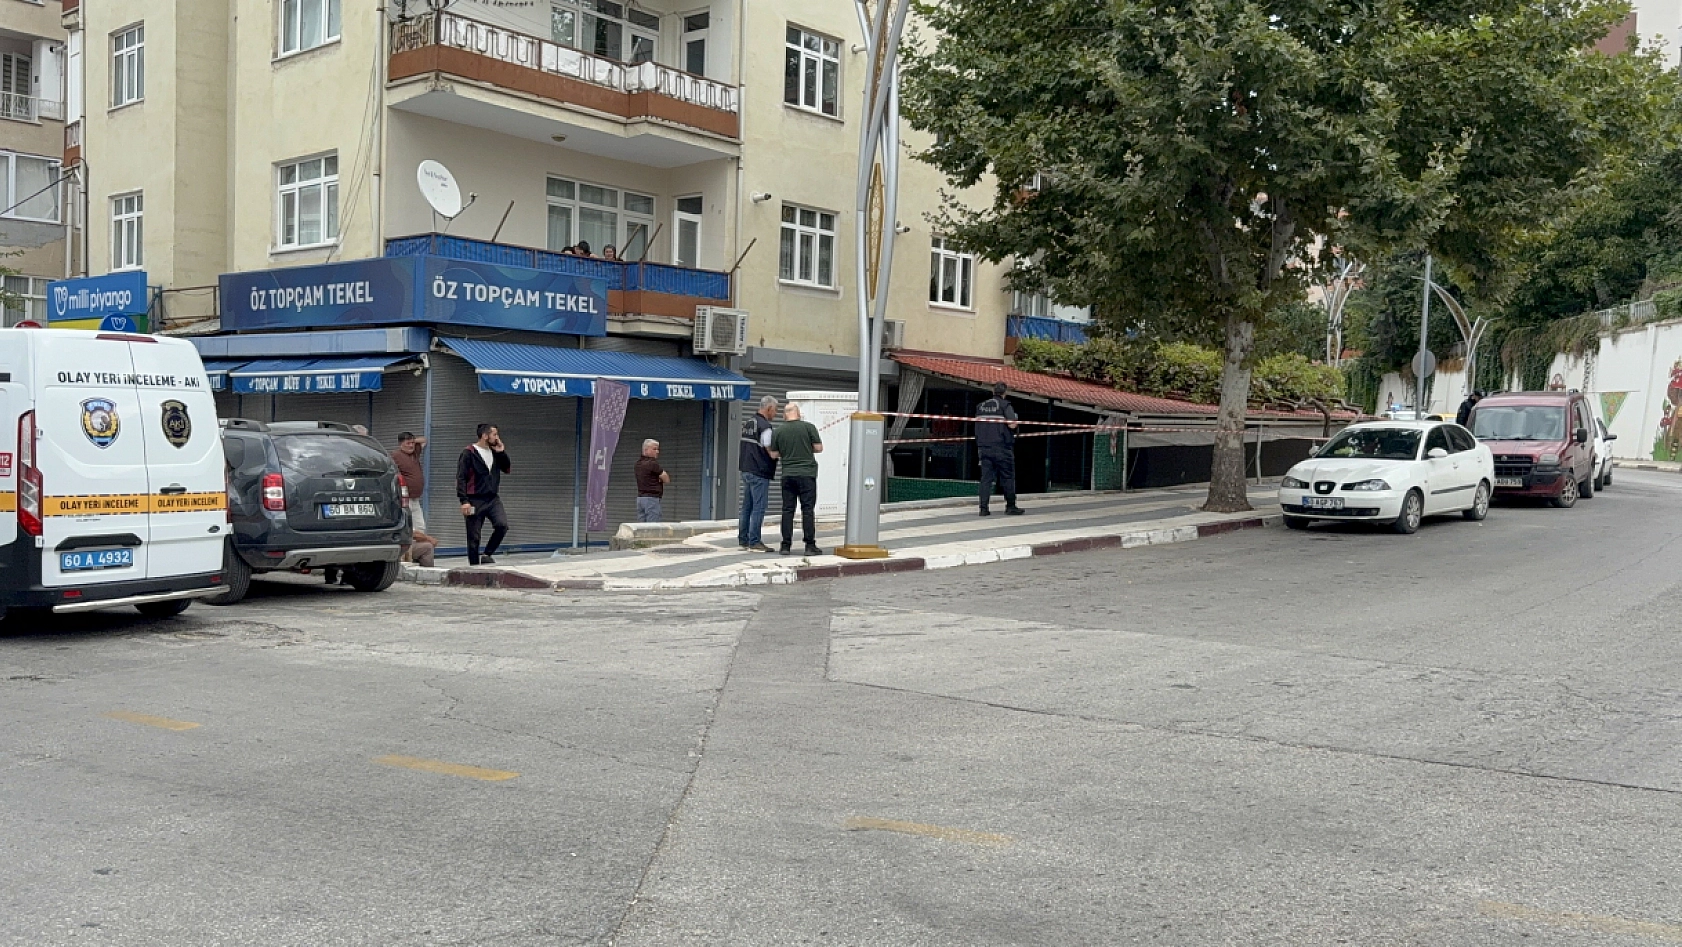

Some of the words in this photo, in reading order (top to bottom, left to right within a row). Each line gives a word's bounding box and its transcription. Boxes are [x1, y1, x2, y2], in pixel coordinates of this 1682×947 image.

[69, 289, 89, 310] milli
[89, 287, 132, 313] piyango
[250, 286, 267, 311] ÖZ
[268, 285, 324, 313] TOPÇAM
[327, 281, 374, 305] TEKEL
[433, 275, 458, 299] ÖZ
[463, 282, 540, 309] TOPÇAM
[544, 291, 598, 314] TEKEL
[57, 371, 91, 384] OLAY
[315, 375, 337, 389] TEKEL
[522, 377, 567, 395] TOPÇAM
[666, 384, 696, 398] TEKEL
[60, 500, 81, 510] OLAY
[158, 498, 176, 508] OLAY
[64, 555, 81, 567] 60
[85, 553, 94, 566] A
[98, 551, 132, 564] 4932
